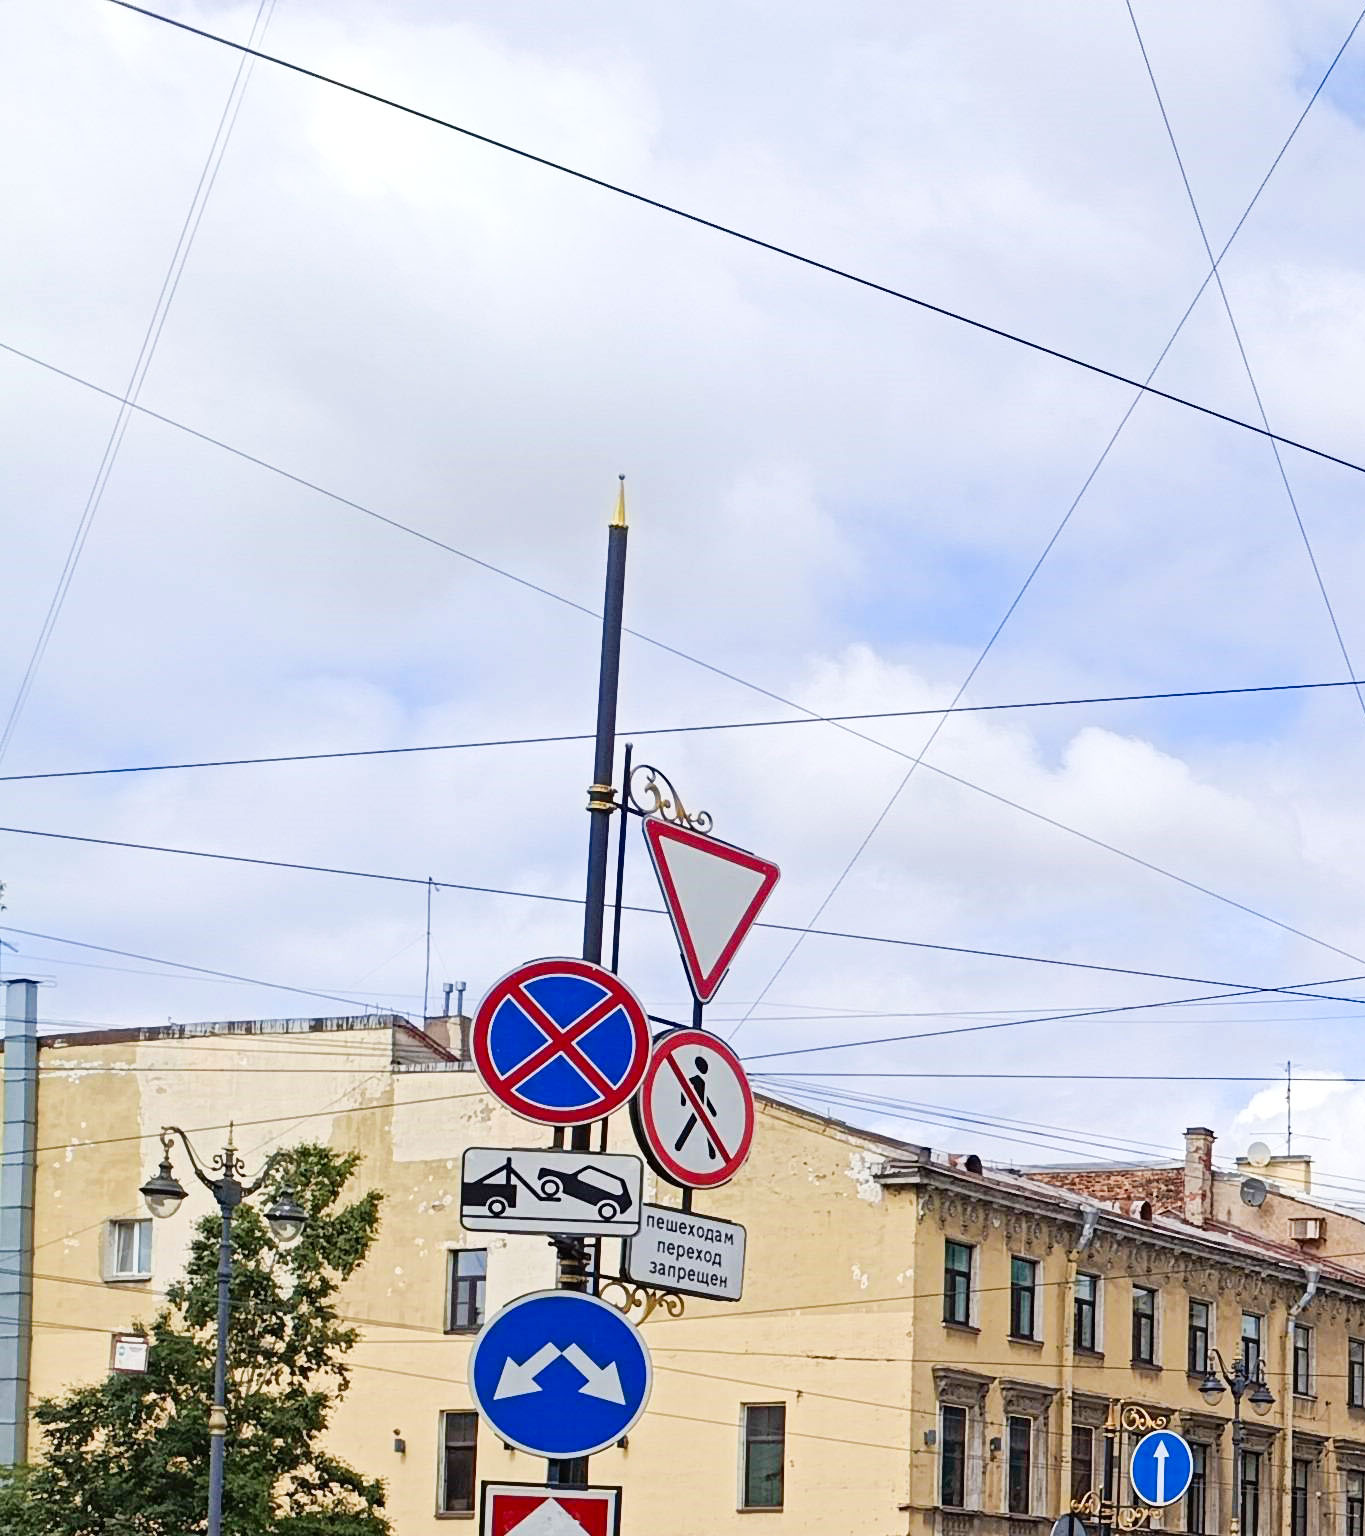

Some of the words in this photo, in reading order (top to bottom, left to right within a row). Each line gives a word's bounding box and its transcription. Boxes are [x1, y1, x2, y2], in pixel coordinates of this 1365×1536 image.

[646, 1214, 735, 1246] пешеходам
[656, 1240, 722, 1268] переход
[648, 1261, 728, 1288] запрещен
